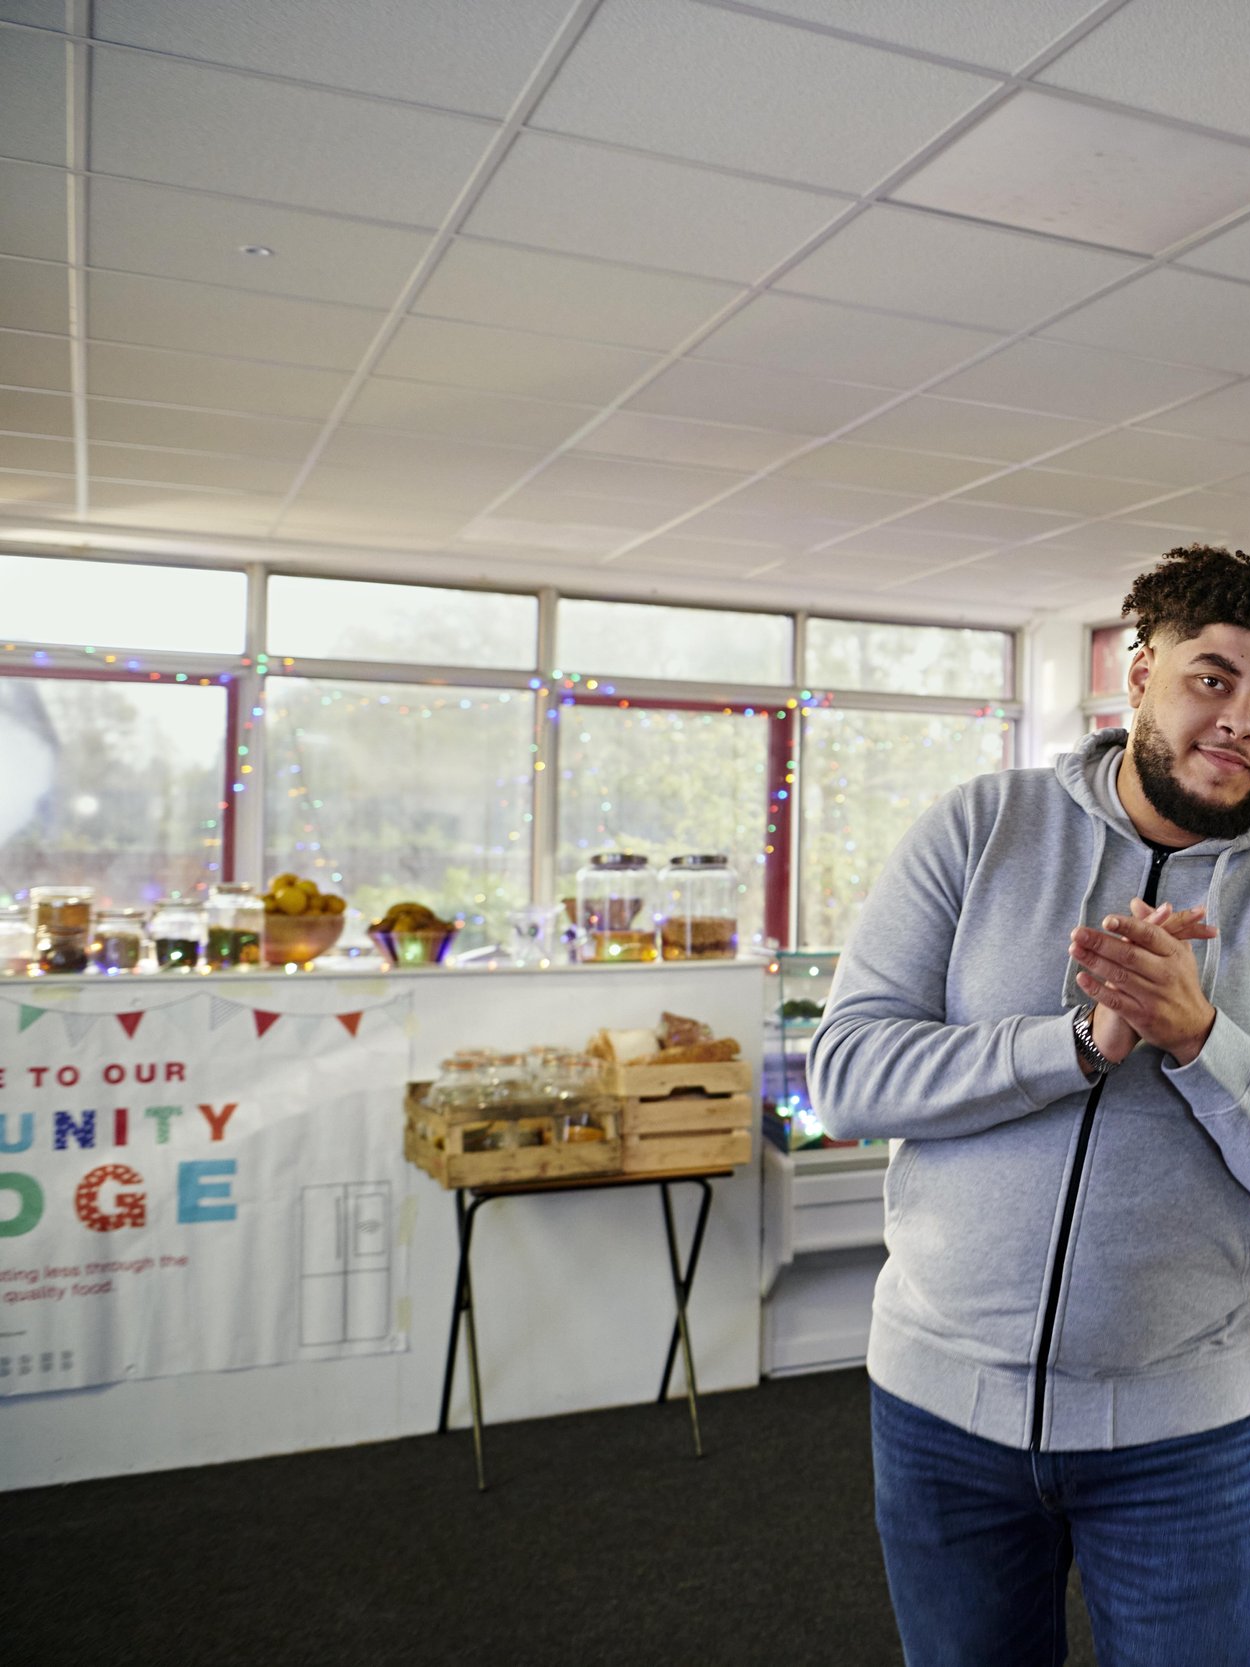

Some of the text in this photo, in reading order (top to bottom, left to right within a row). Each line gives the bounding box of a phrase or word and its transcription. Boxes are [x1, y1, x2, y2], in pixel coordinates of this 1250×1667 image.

[28, 1066, 80, 1088] TO
[103, 1062, 187, 1085] OUR
[0, 1103, 238, 1154] UNITY
[44, 1266, 80, 1279] less
[85, 1260, 154, 1274] through
[160, 1255, 189, 1269] the
